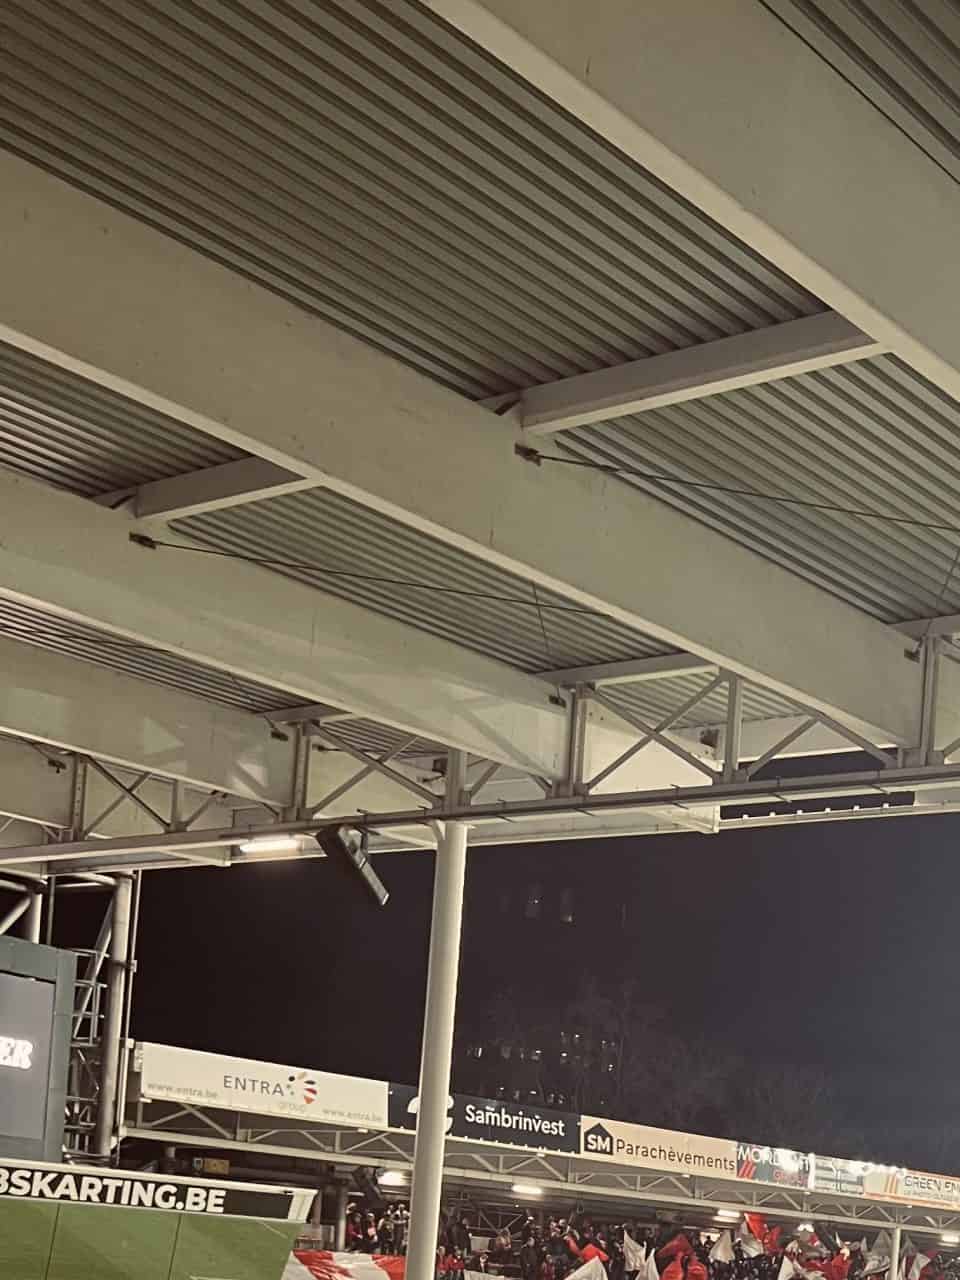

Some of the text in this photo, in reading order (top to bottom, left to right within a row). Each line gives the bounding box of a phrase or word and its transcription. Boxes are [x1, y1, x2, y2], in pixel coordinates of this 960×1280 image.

[223, 1074, 285, 1097] ENTRA
[465, 1104, 565, 1137] Sambrinvest
[587, 1134, 611, 1153] SM
[904, 1175, 943, 1192] GREEN
